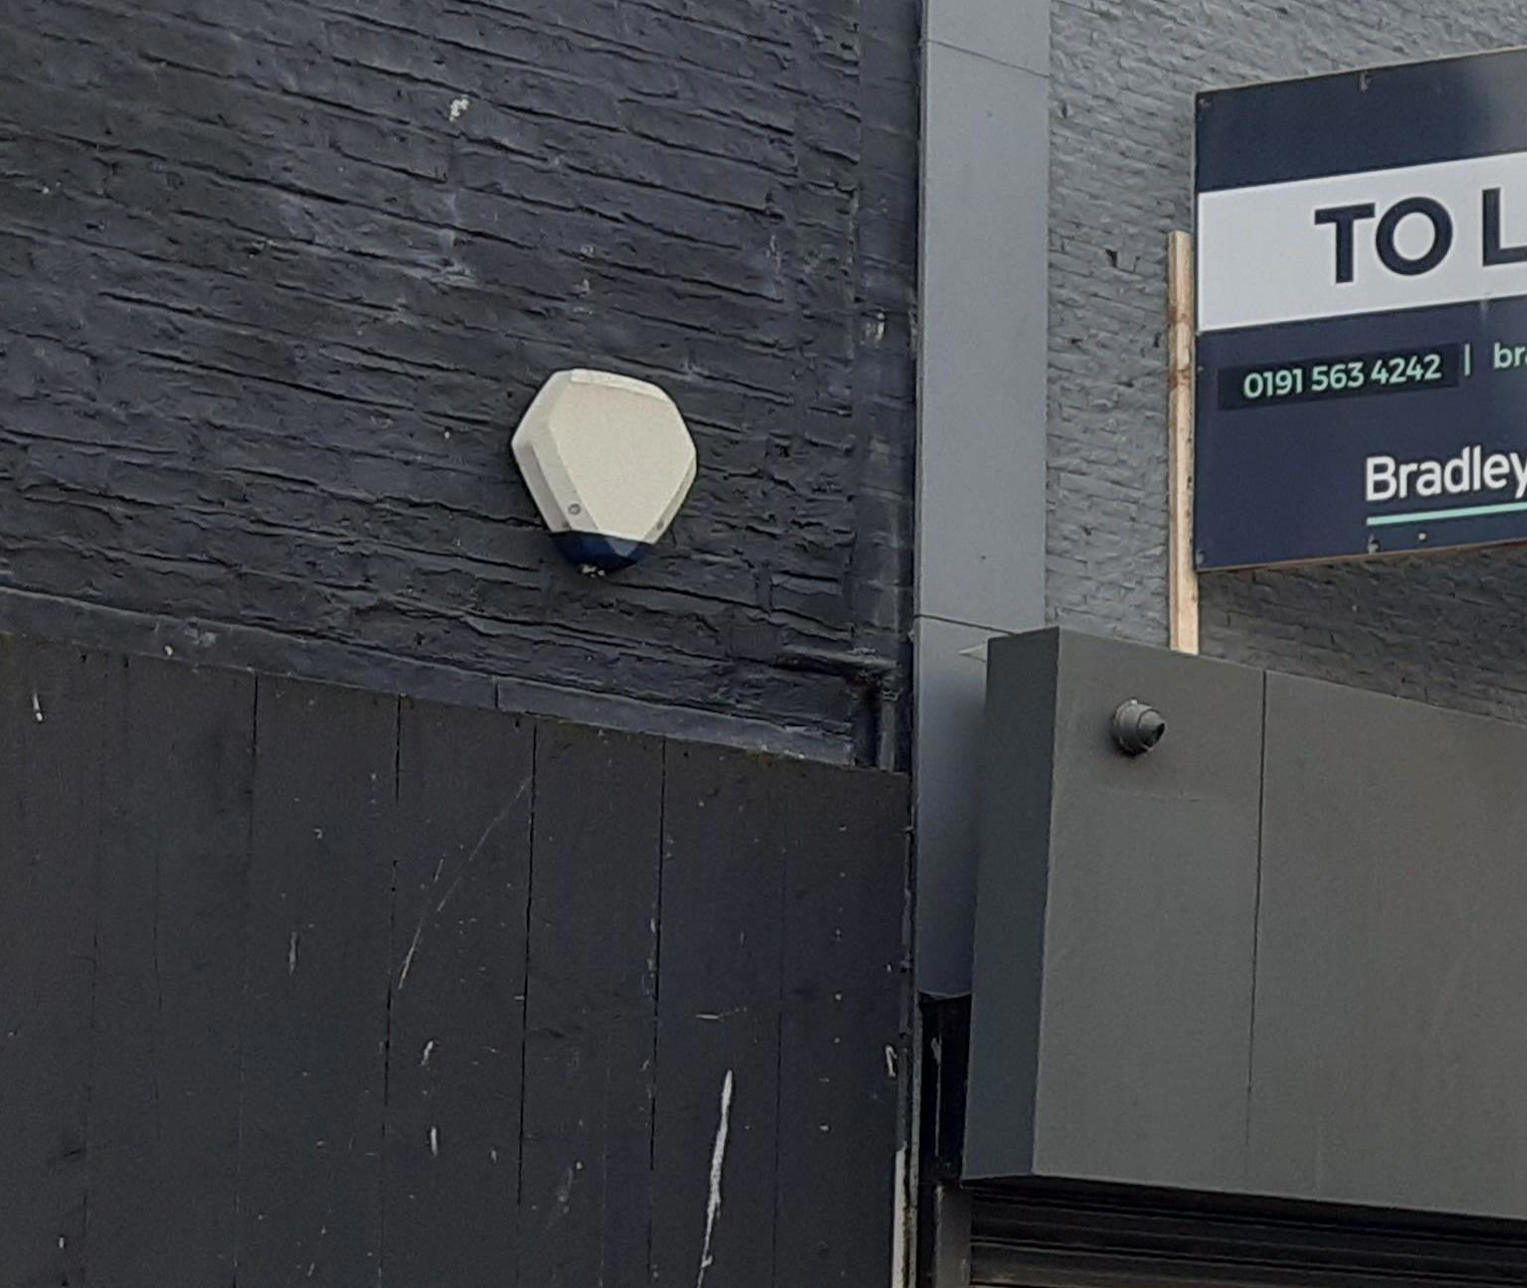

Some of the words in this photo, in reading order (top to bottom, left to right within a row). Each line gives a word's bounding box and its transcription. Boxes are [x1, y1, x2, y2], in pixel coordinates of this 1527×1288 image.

[1314, 196, 1454, 284] TO
[1243, 368, 1303, 399] 0191
[1311, 361, 1364, 392] 563
[1371, 354, 1441, 385] 4242
